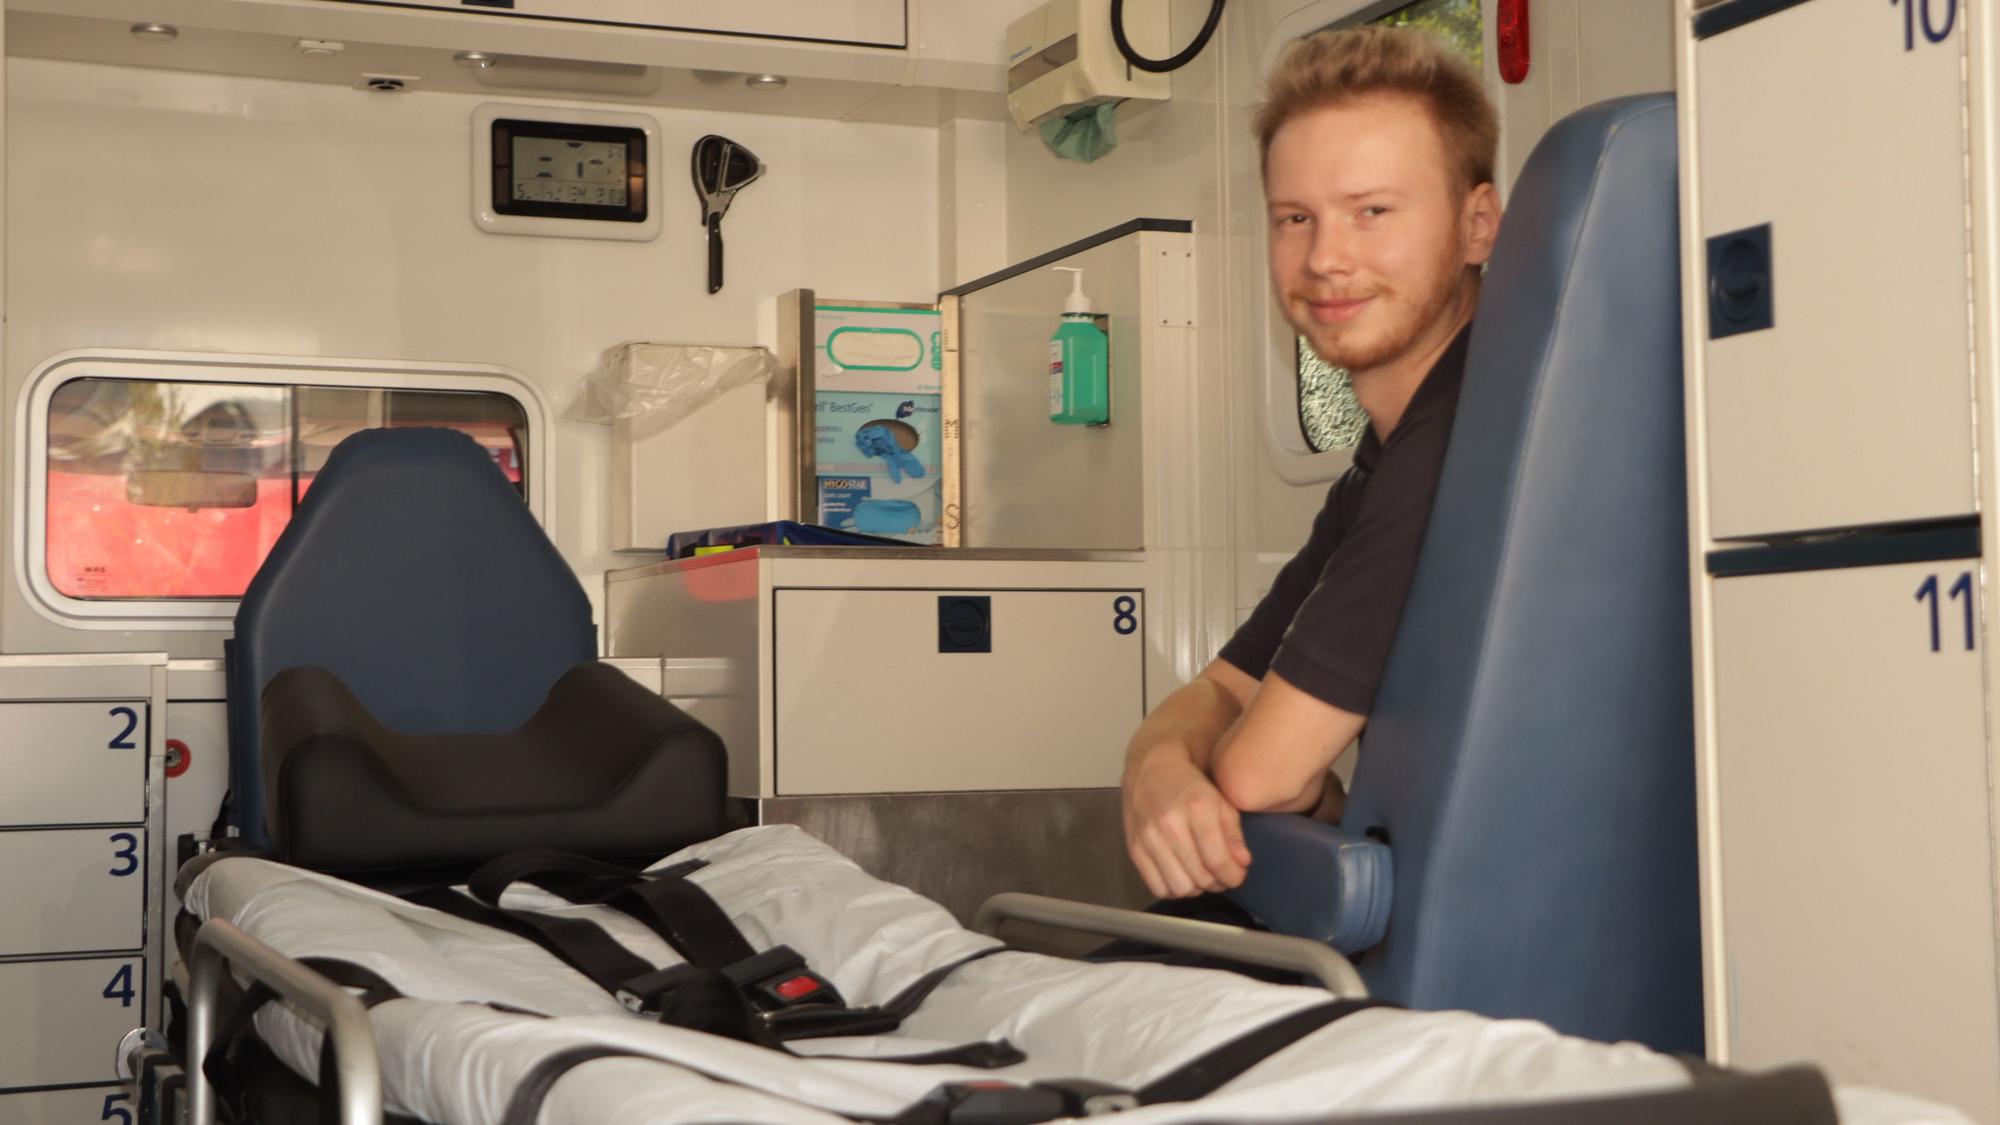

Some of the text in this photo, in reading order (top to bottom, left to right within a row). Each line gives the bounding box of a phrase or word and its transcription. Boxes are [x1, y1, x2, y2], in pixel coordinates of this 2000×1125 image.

[1113, 595, 1137, 635] 8
[1915, 571, 1974, 652] 11
[108, 706, 138, 750] 2
[109, 832, 138, 877] 3
[102, 964, 135, 1008] 4
[101, 1092, 132, 1125] 5
